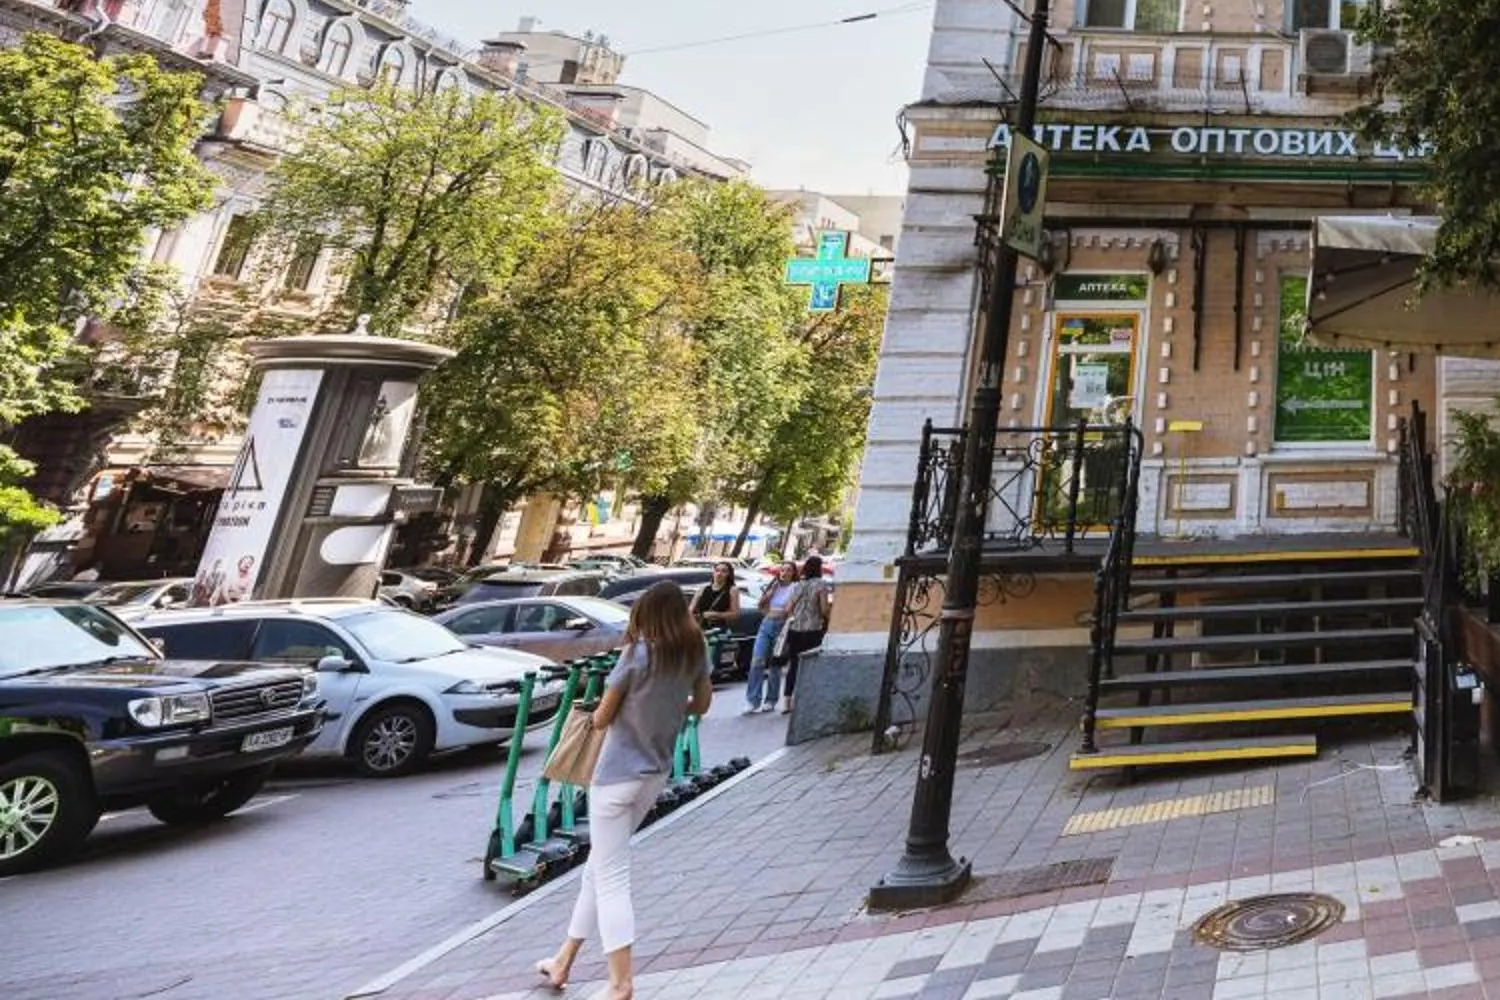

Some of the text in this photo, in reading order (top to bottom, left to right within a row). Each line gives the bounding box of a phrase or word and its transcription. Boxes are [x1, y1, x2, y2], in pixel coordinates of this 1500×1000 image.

[1171, 127, 1356, 155] ОПТОВИХ
[1079, 282, 1128, 293] АПТЕКА
[1303, 361, 1345, 380] ЦІН
